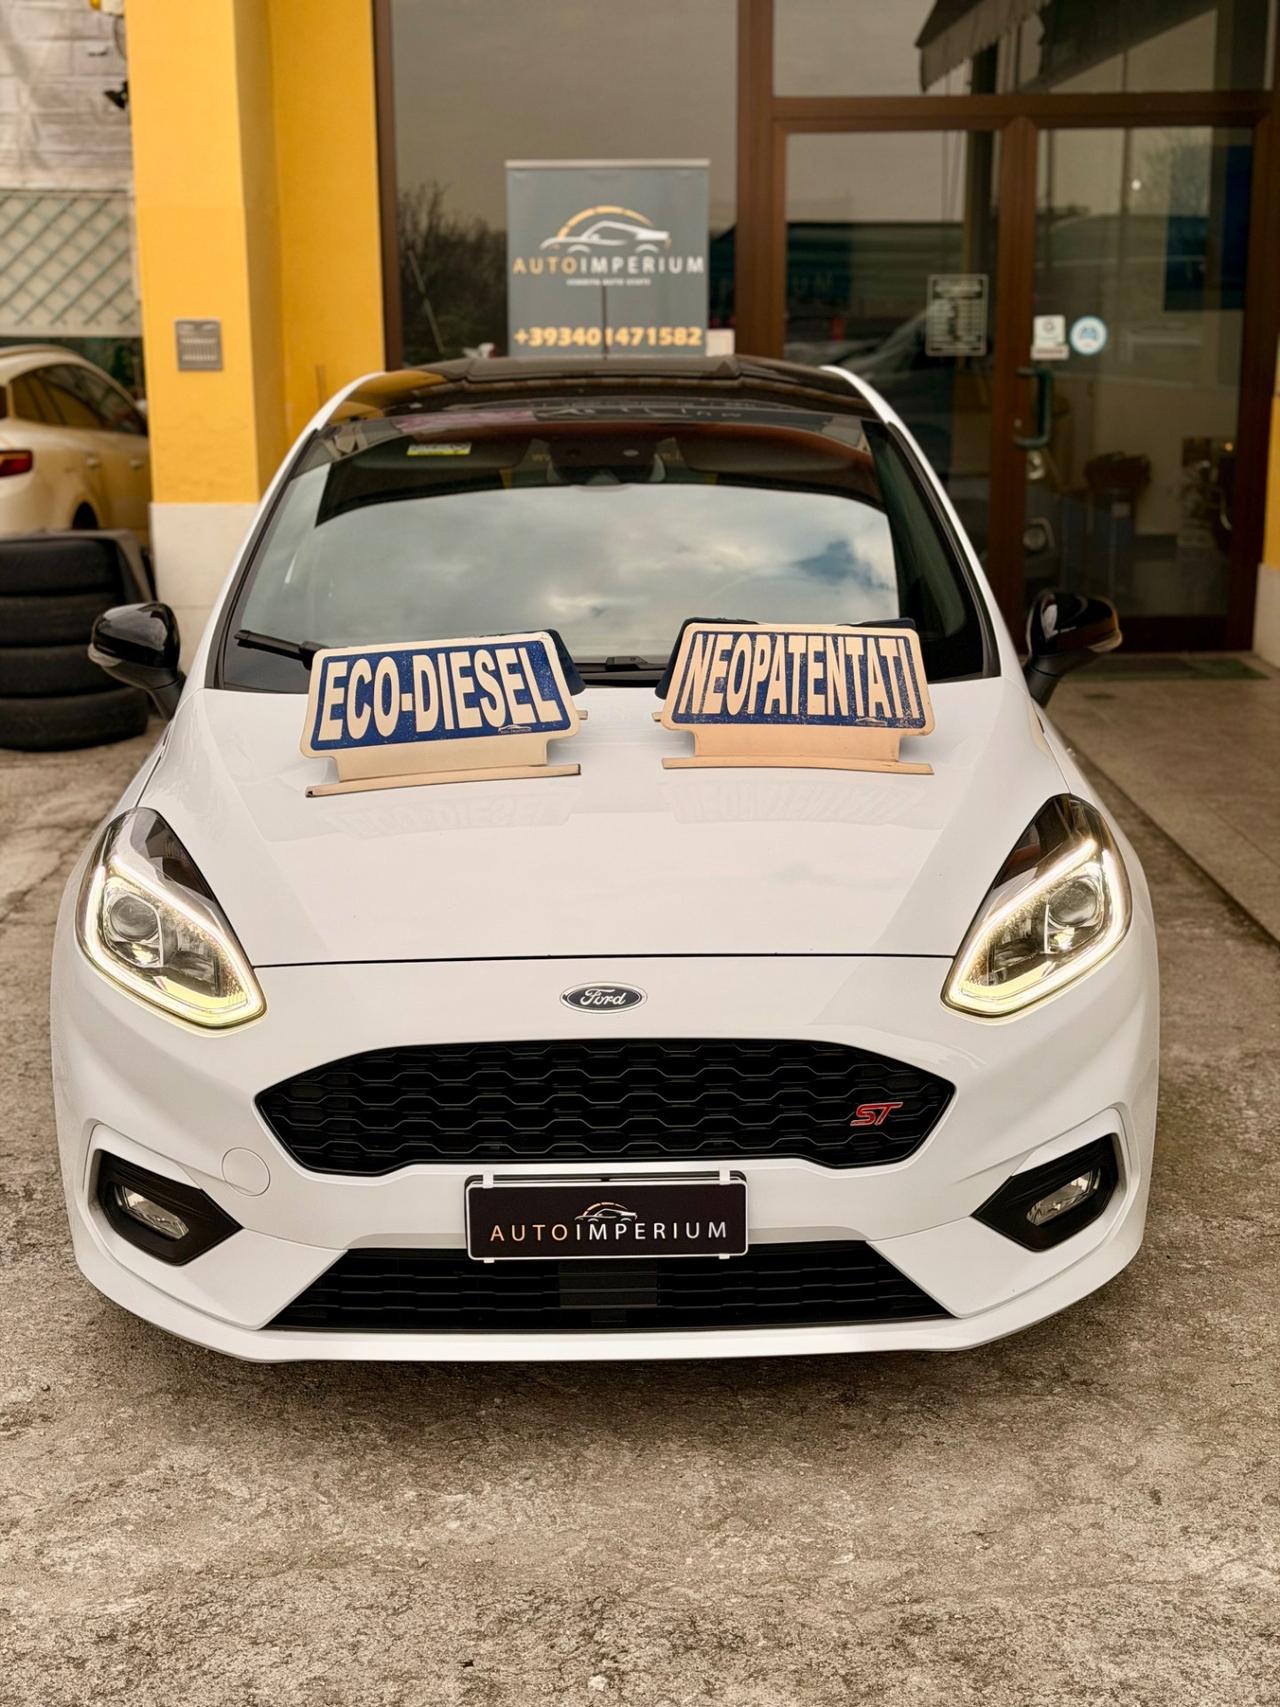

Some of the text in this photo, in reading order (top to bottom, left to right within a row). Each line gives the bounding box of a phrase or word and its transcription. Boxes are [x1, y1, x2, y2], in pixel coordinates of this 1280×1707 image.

[512, 256, 704, 274] AUTOIMPERIUM
[514, 326, 703, 347] +393401471582
[678, 633, 920, 718] NEOPATENTATI
[317, 647, 563, 741] ECO-DIESEL
[580, 988, 627, 1006] Ford
[850, 1101, 904, 1127] ST
[490, 1221, 727, 1242] AUTOIMPERIUM
